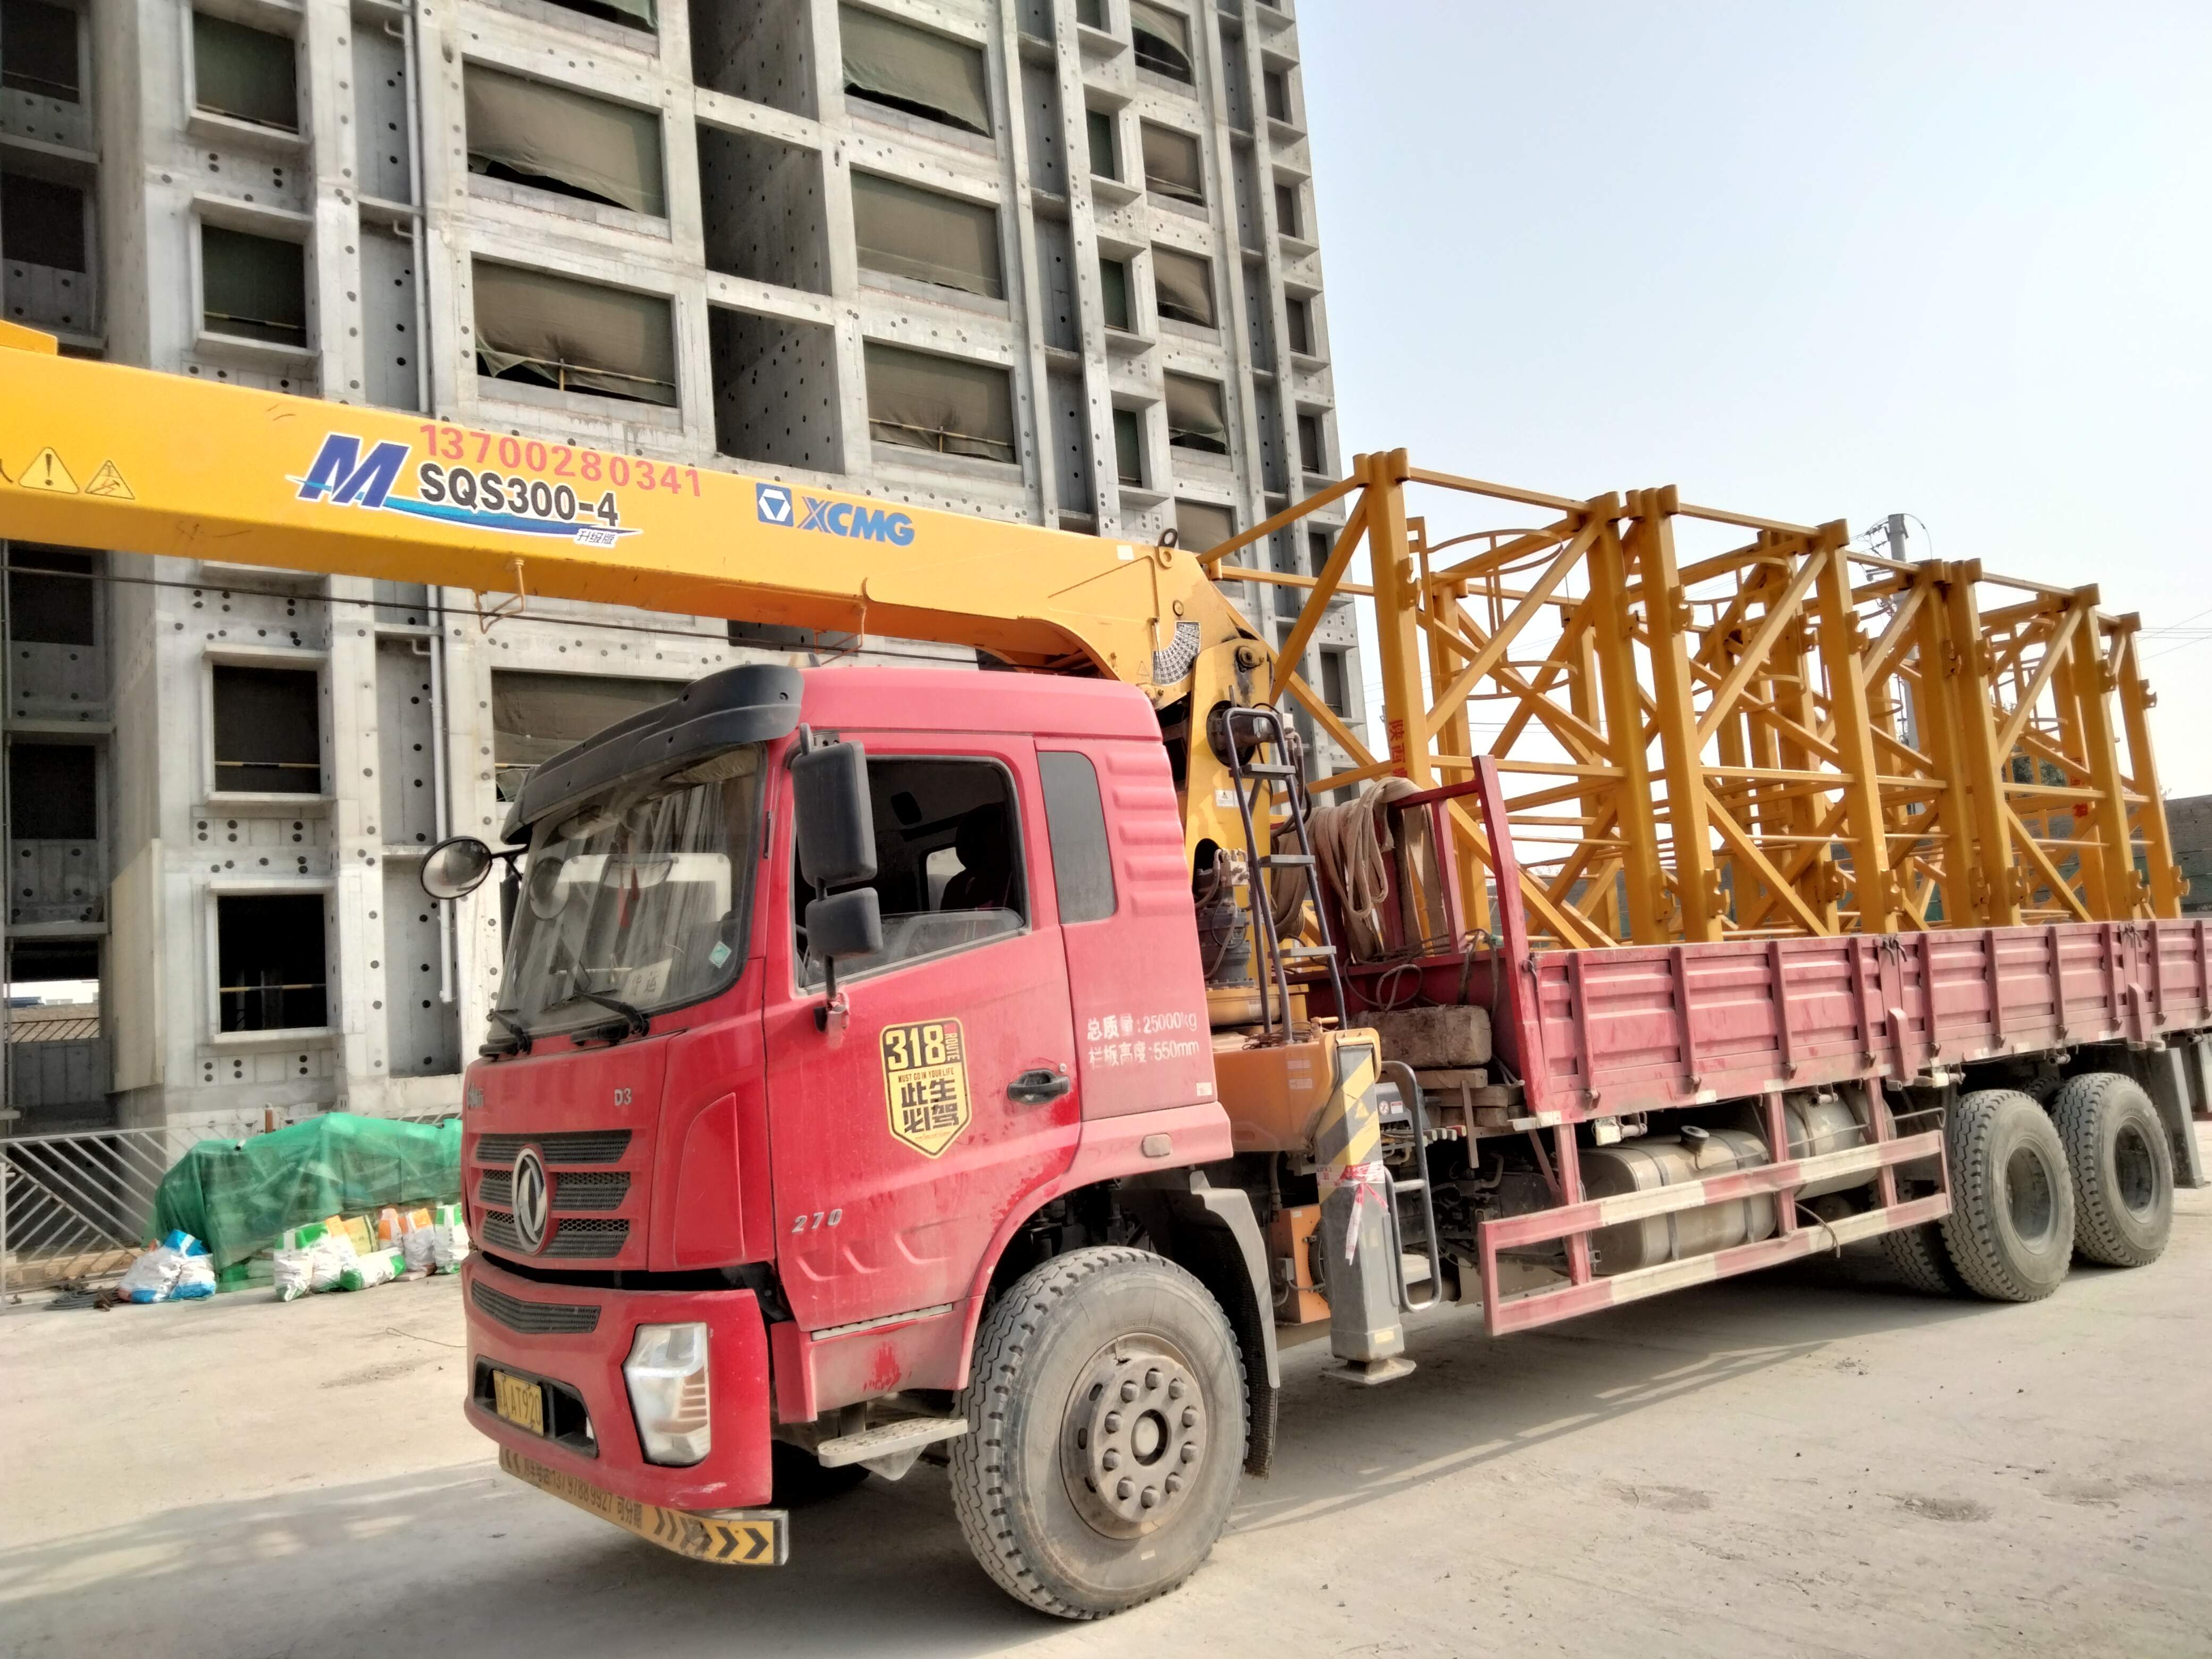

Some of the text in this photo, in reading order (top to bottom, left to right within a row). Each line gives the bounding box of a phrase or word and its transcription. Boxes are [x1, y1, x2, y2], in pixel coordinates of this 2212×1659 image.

[420, 424, 701, 497] 13700280341
[420, 462, 619, 527] SQS300-4
[797, 496, 916, 547] XCMG
[578, 530, 616, 545] 升级版
[885, 1024, 946, 1071] 318
[944, 1032, 960, 1061] ROUTE
[898, 1073, 912, 1083] MUST
[928, 1069, 942, 1079] YOUR
[942, 1067, 954, 1077] LIFE
[614, 1087, 632, 1107] D3
[901, 1077, 957, 1108] 此生
[902, 1101, 960, 1134] 必驾
[791, 1208, 843, 1233] 270
